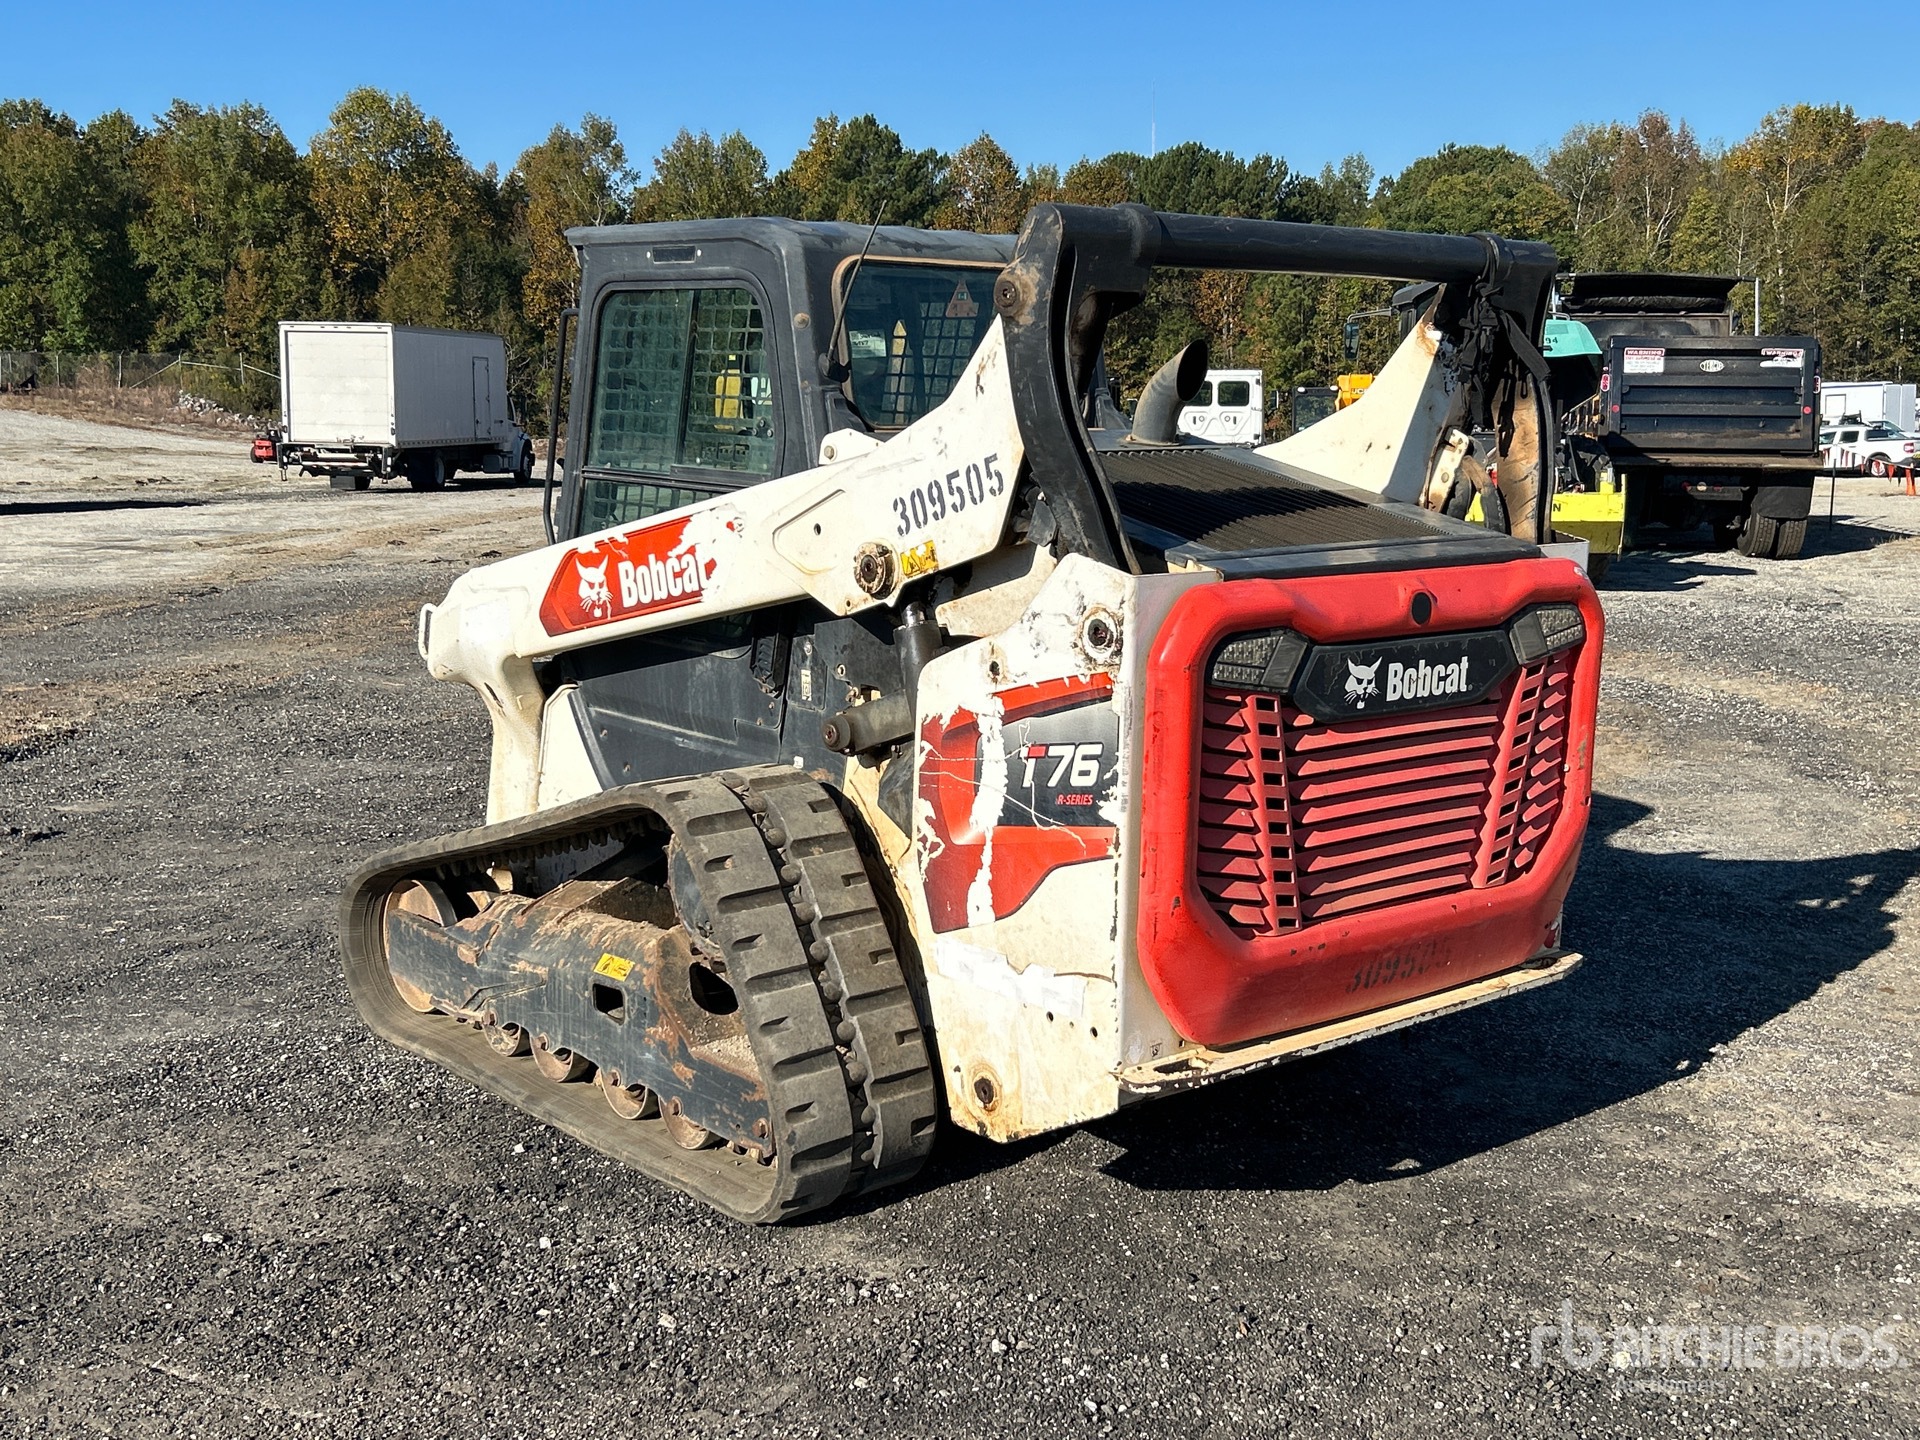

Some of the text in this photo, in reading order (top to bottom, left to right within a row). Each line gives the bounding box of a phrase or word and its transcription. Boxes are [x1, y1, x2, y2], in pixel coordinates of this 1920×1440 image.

[893, 453, 1004, 537] 309505
[1386, 656, 1469, 702] Bobcat
[1019, 742, 1103, 788] T76
[1056, 794, 1094, 805] R-SERIES
